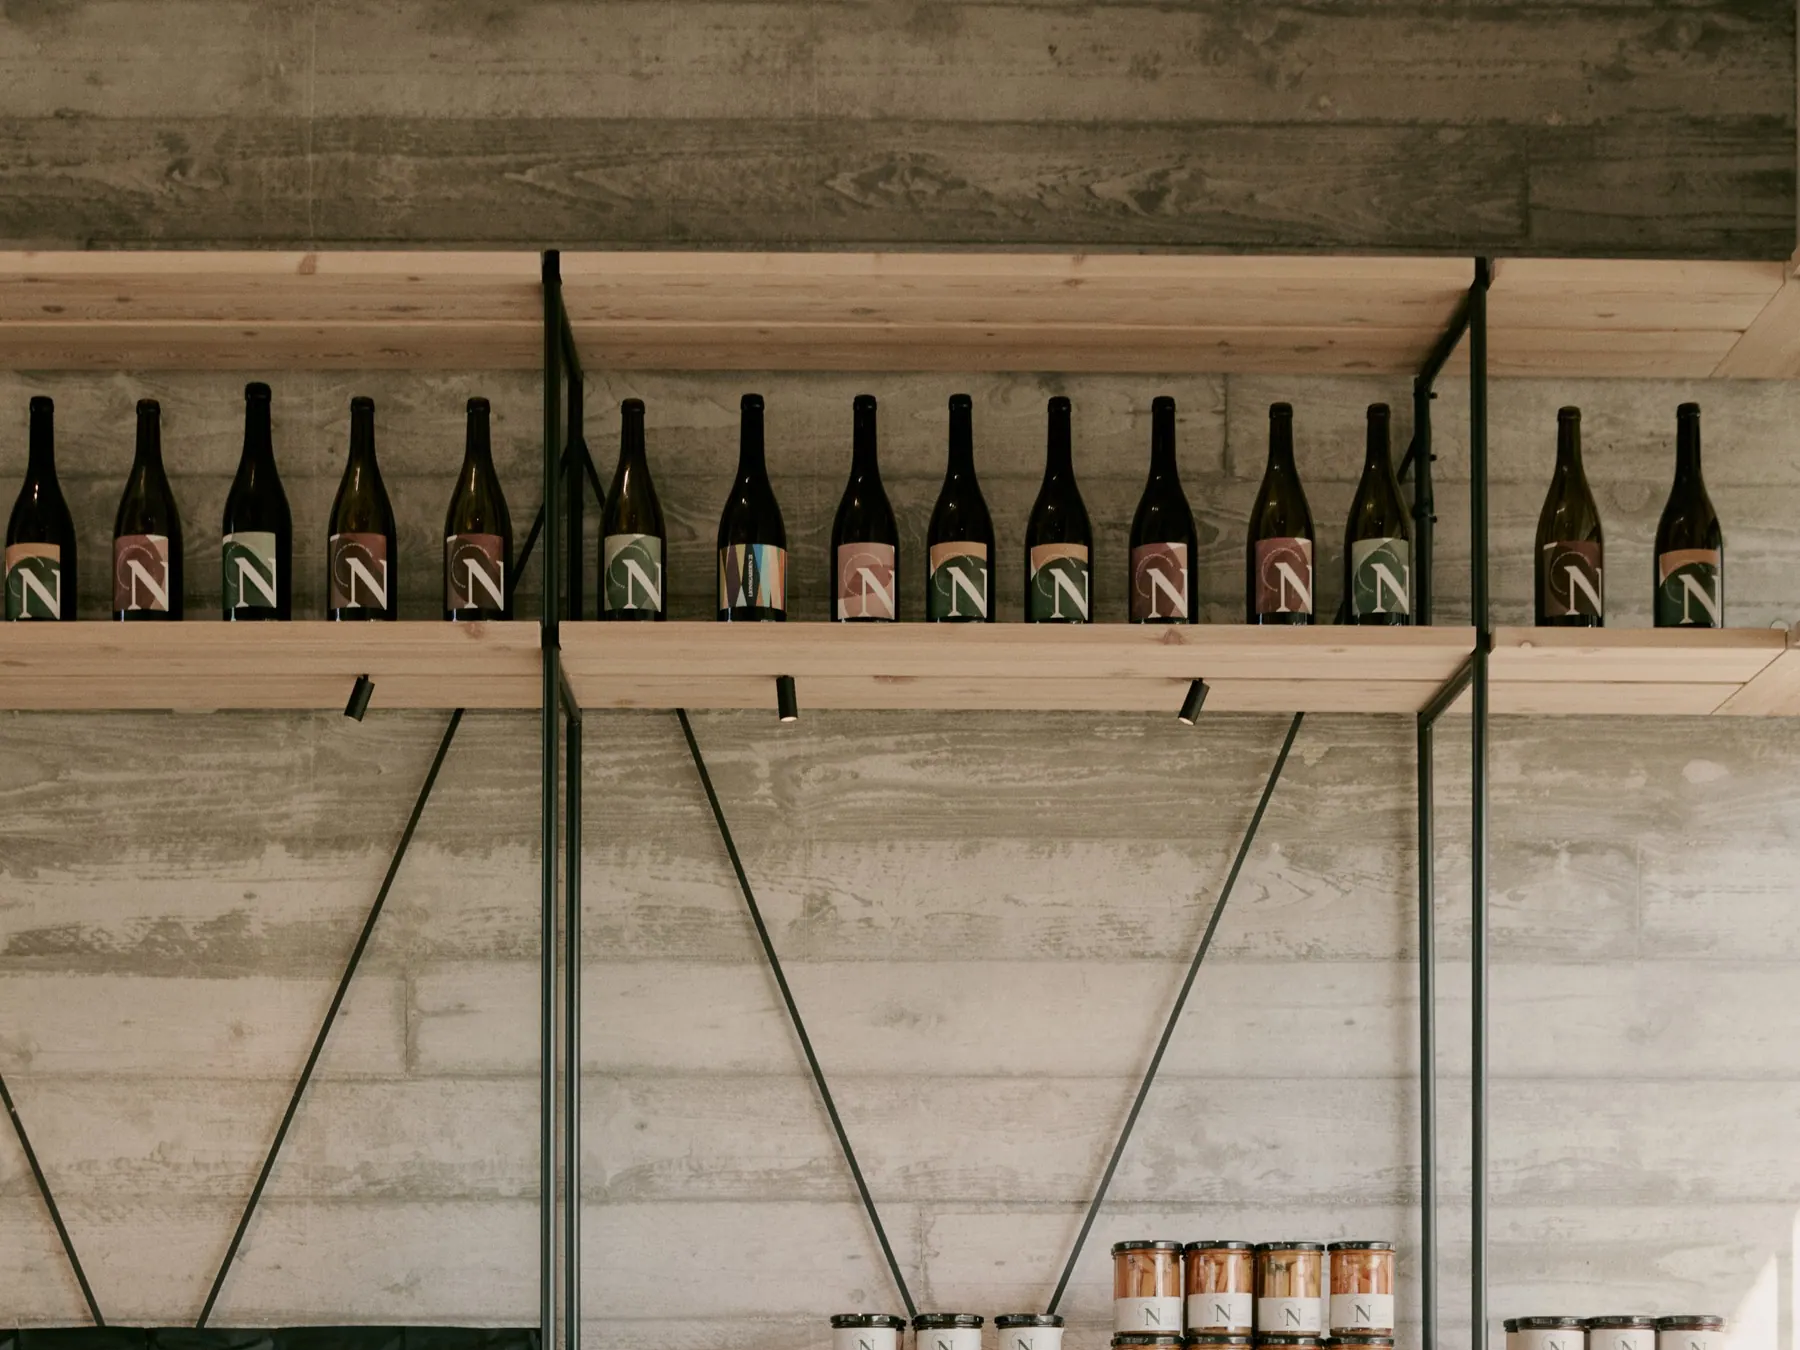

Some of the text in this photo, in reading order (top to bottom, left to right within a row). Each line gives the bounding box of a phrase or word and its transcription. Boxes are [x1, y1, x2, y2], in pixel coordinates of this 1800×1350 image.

[18, 569, 60, 620] N
[127, 559, 169, 611] N
[235, 557, 276, 608] N
[346, 557, 387, 610] N
[463, 559, 504, 612] N
[621, 559, 661, 612] N
[857, 567, 894, 620] N
[947, 567, 986, 618] N
[1049, 568, 1088, 620] N
[1146, 568, 1188, 618] N
[1274, 562, 1312, 615] N
[1371, 563, 1409, 615] N
[1564, 566, 1601, 617] N
[1678, 574, 1721, 628] N
[1145, 1308, 1160, 1326] N
[1215, 1304, 1231, 1322] N
[1285, 1308, 1301, 1326] N
[1355, 1304, 1371, 1322] N
